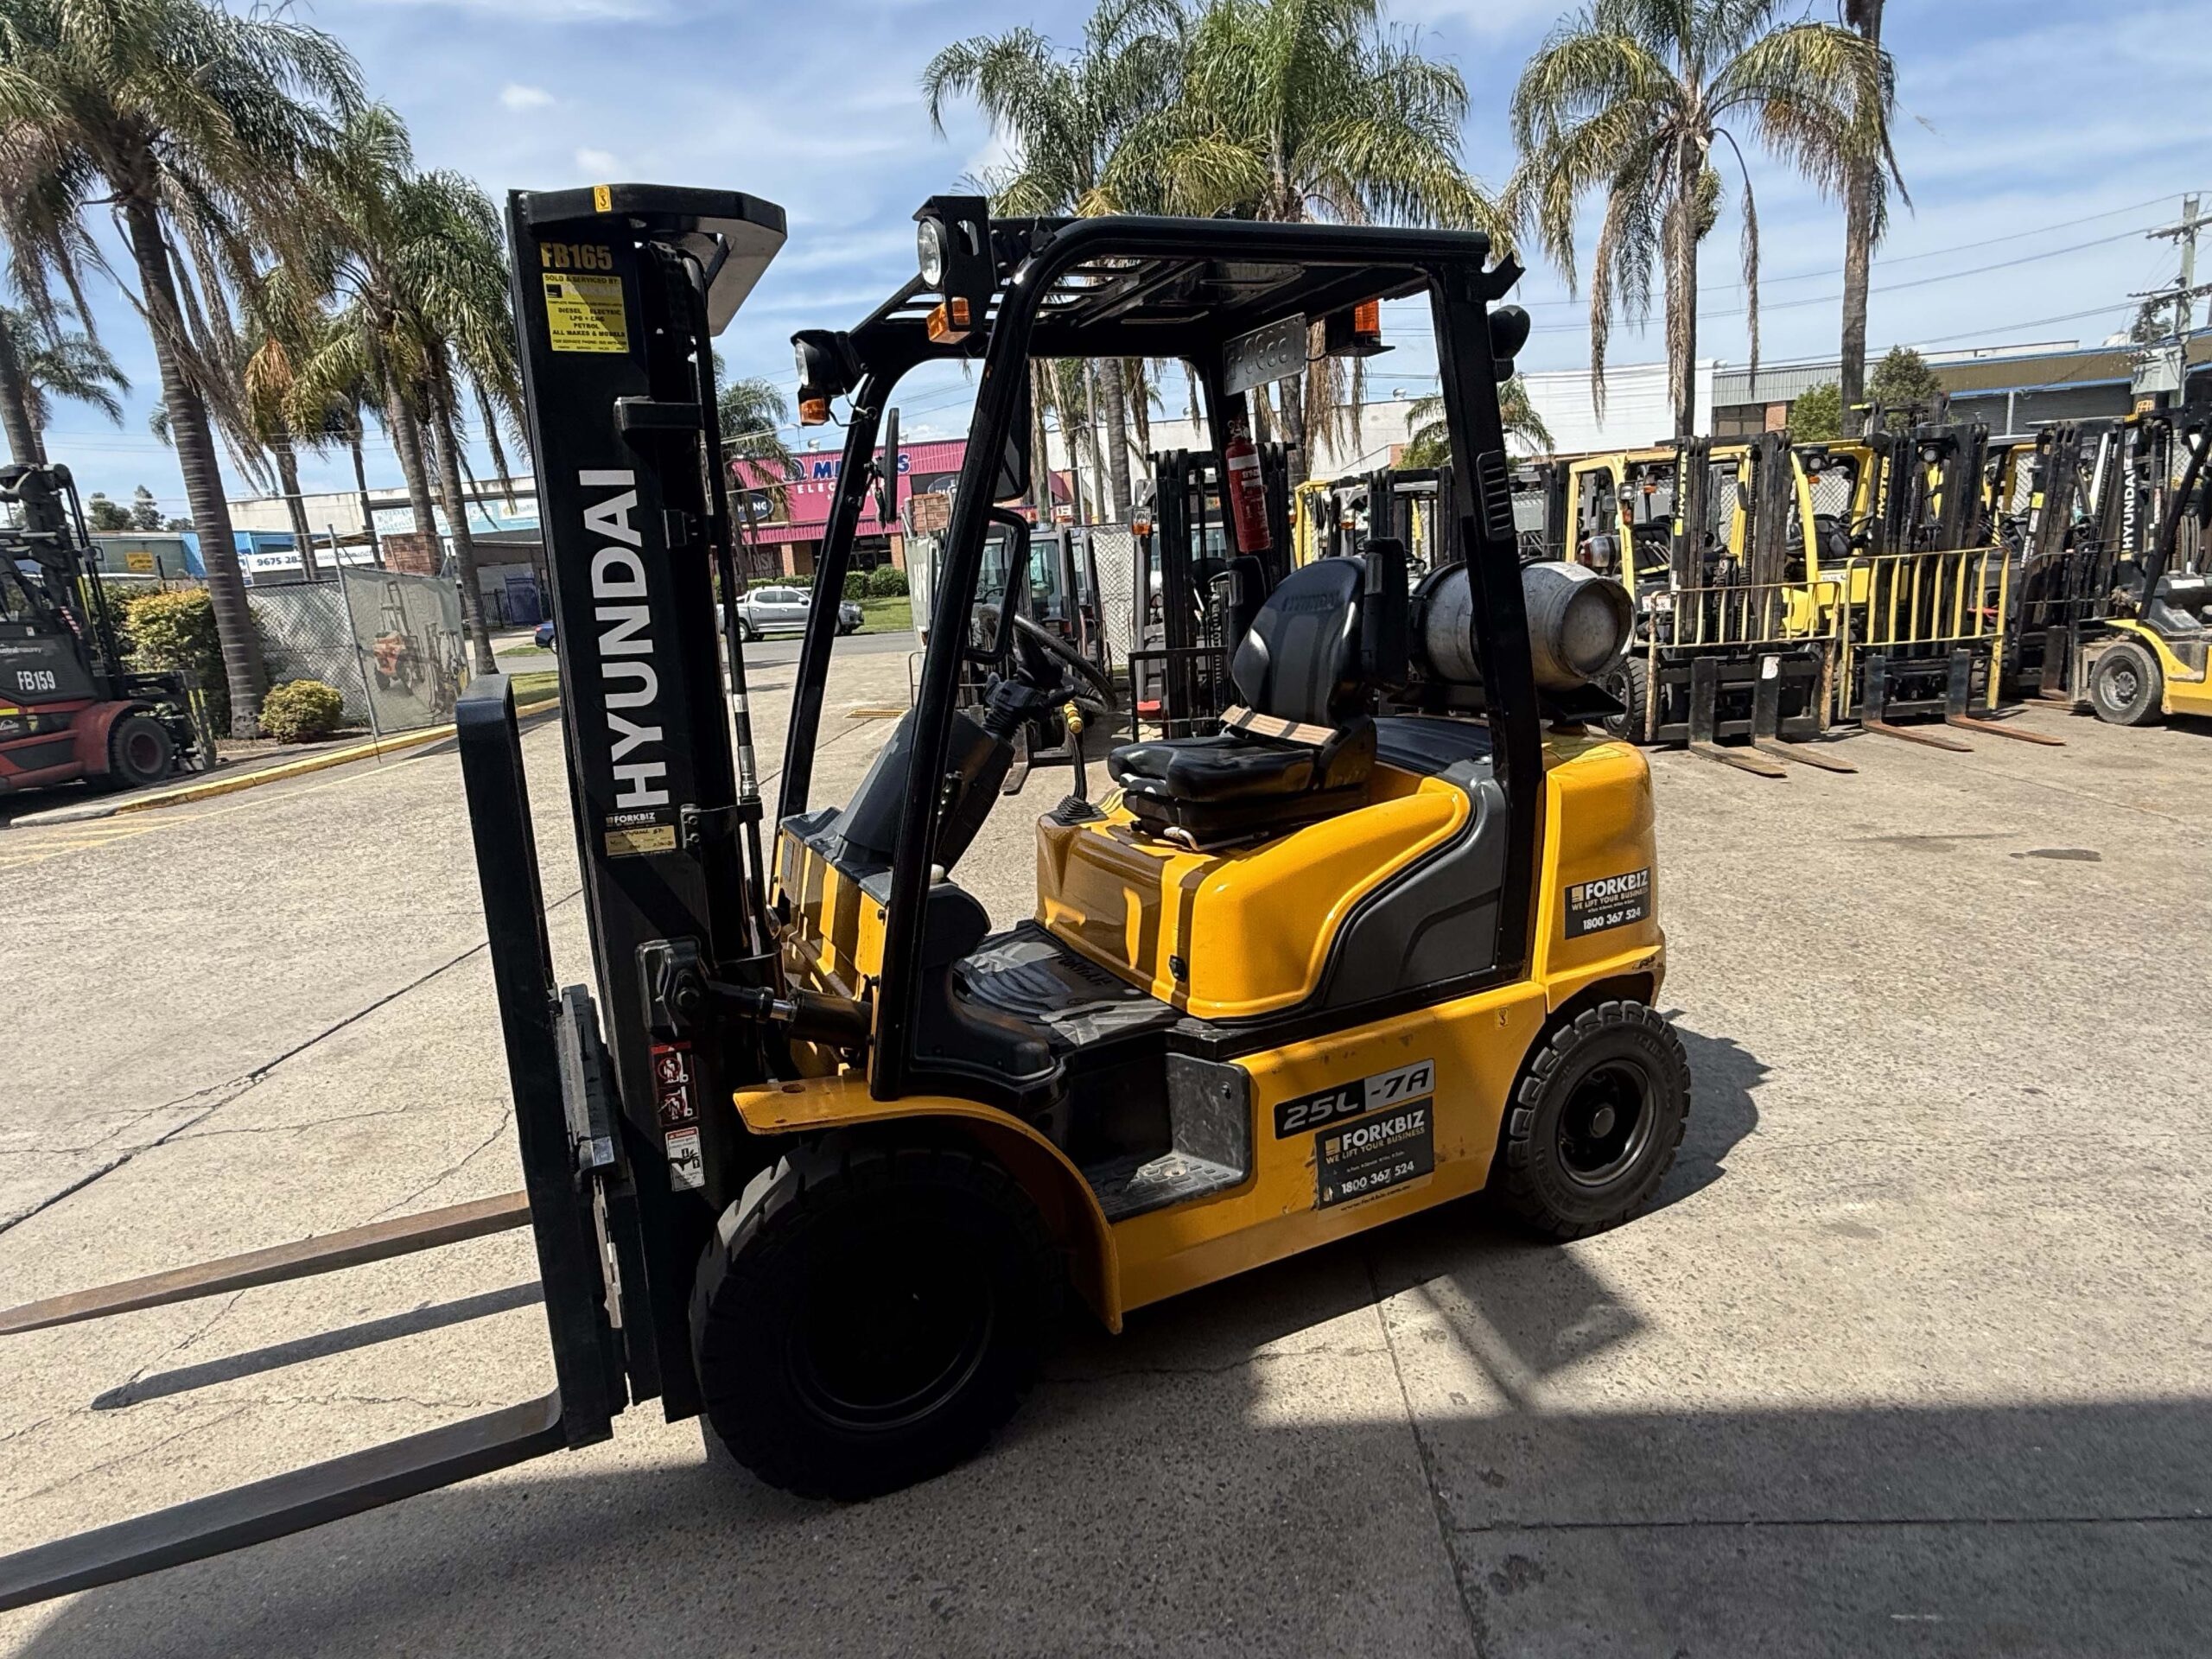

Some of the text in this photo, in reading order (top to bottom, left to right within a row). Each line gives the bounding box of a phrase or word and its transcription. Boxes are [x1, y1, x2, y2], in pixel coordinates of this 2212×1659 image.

[540, 242, 613, 270] FB165
[1678, 451, 1688, 518] HYSTER
[1877, 456, 1891, 519] HYSTER
[2123, 469, 2136, 549] HYUNDAI
[257, 557, 282, 567] 9675
[579, 470, 671, 808] HYUNDAI
[16, 671, 55, 690] FB159
[614, 812, 656, 823] FORKBIZ
[1586, 870, 1649, 900] FORKBIZ
[1572, 902, 1583, 911] WE
[1585, 899, 1598, 909] LIFT
[1599, 894, 1618, 905] YOUR
[1583, 906, 1641, 931] 1800 367 524
[1283, 1092, 1358, 1130] 25L
[1325, 1154, 1339, 1165] WE
[1343, 1148, 1358, 1160] LIFT
[1361, 1141, 1384, 1153] YOUR
[1387, 1127, 1425, 1145] BUSINESS
[1343, 1109, 1425, 1151] FORKBIZ
[1341, 1176, 1369, 1193] 1800
[1370, 1168, 1391, 1184] 367
[1395, 1160, 1414, 1176] 524
